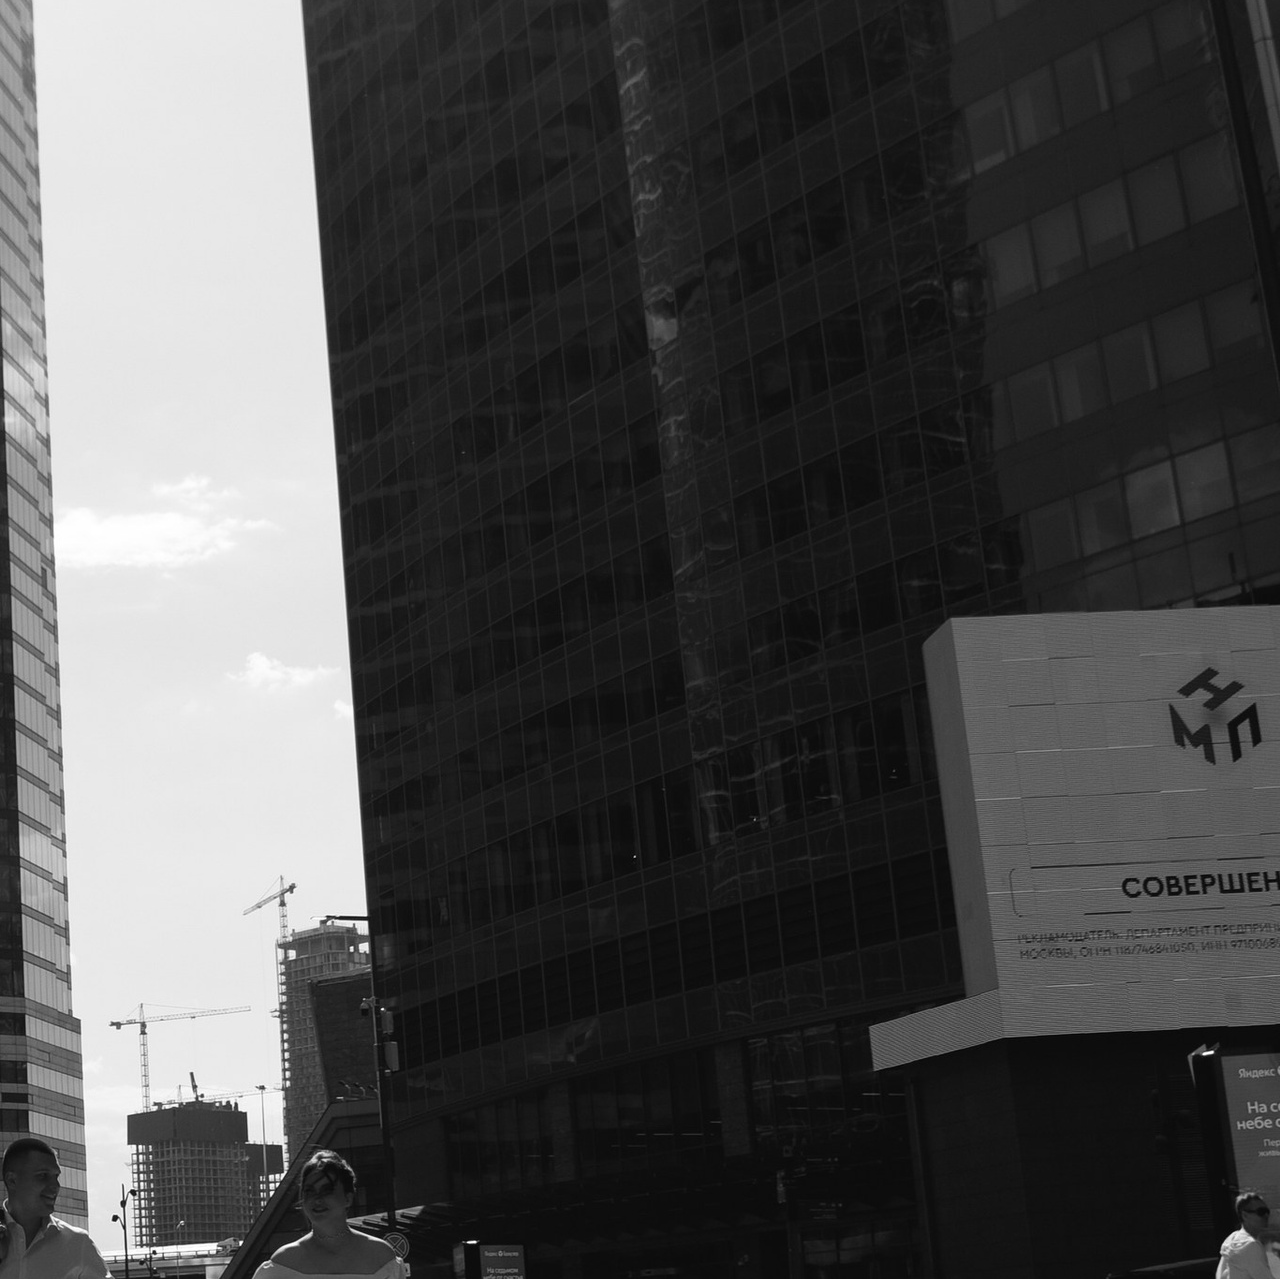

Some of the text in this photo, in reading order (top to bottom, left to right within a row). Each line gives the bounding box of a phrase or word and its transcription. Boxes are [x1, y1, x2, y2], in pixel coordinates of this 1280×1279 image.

[1238, 1067, 1276, 1079] Яндекс
[1246, 1101, 1268, 1114] На
[1237, 1116, 1273, 1130] небе
